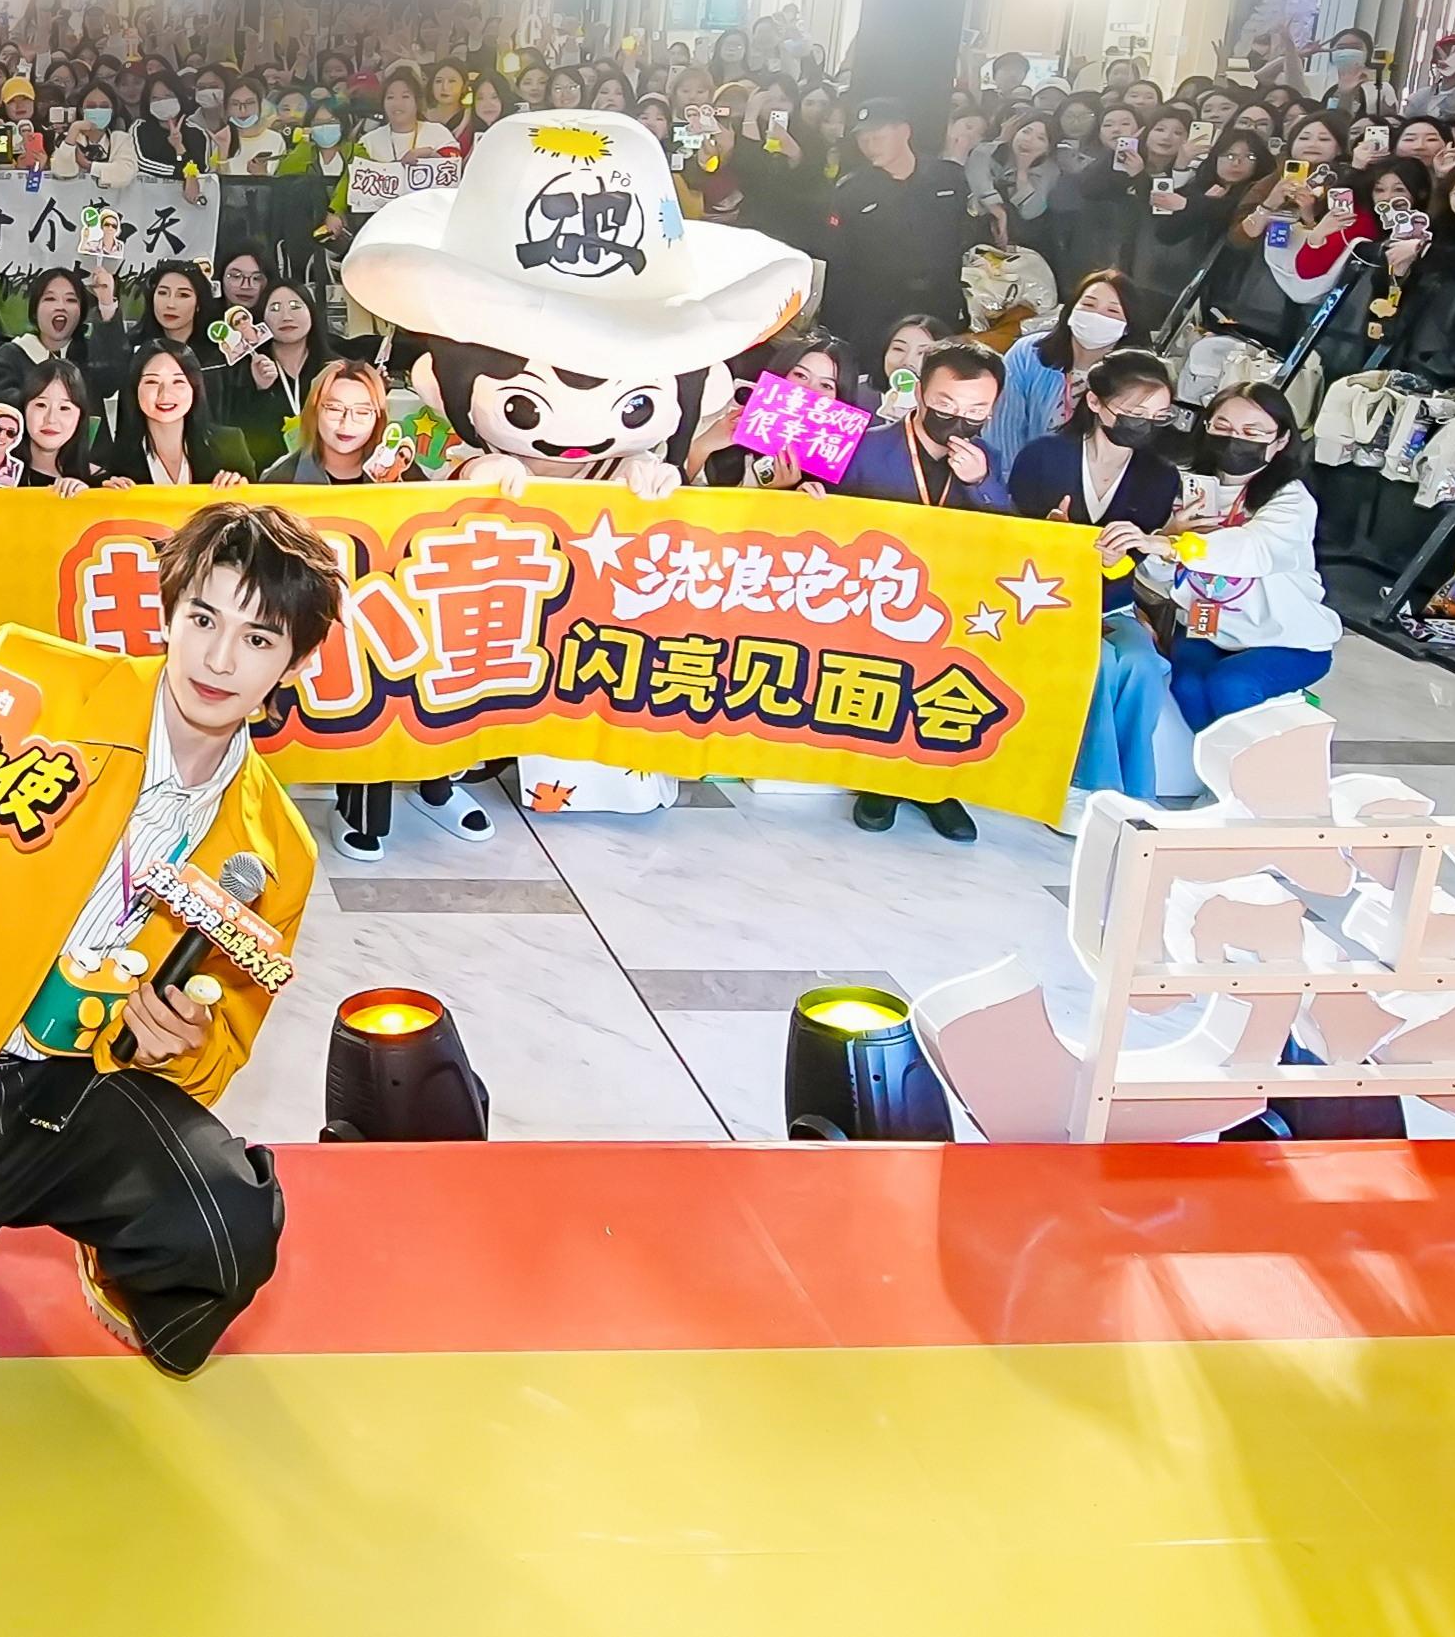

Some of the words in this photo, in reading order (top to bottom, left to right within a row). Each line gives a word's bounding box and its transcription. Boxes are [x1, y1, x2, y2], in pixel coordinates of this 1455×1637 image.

[352, 161, 459, 199] 欢迎回家
[756, 384, 868, 435] 小童喜欢你
[609, 532, 945, 643] 流浪泡泡
[558, 622, 999, 744] 闪亮见面会
